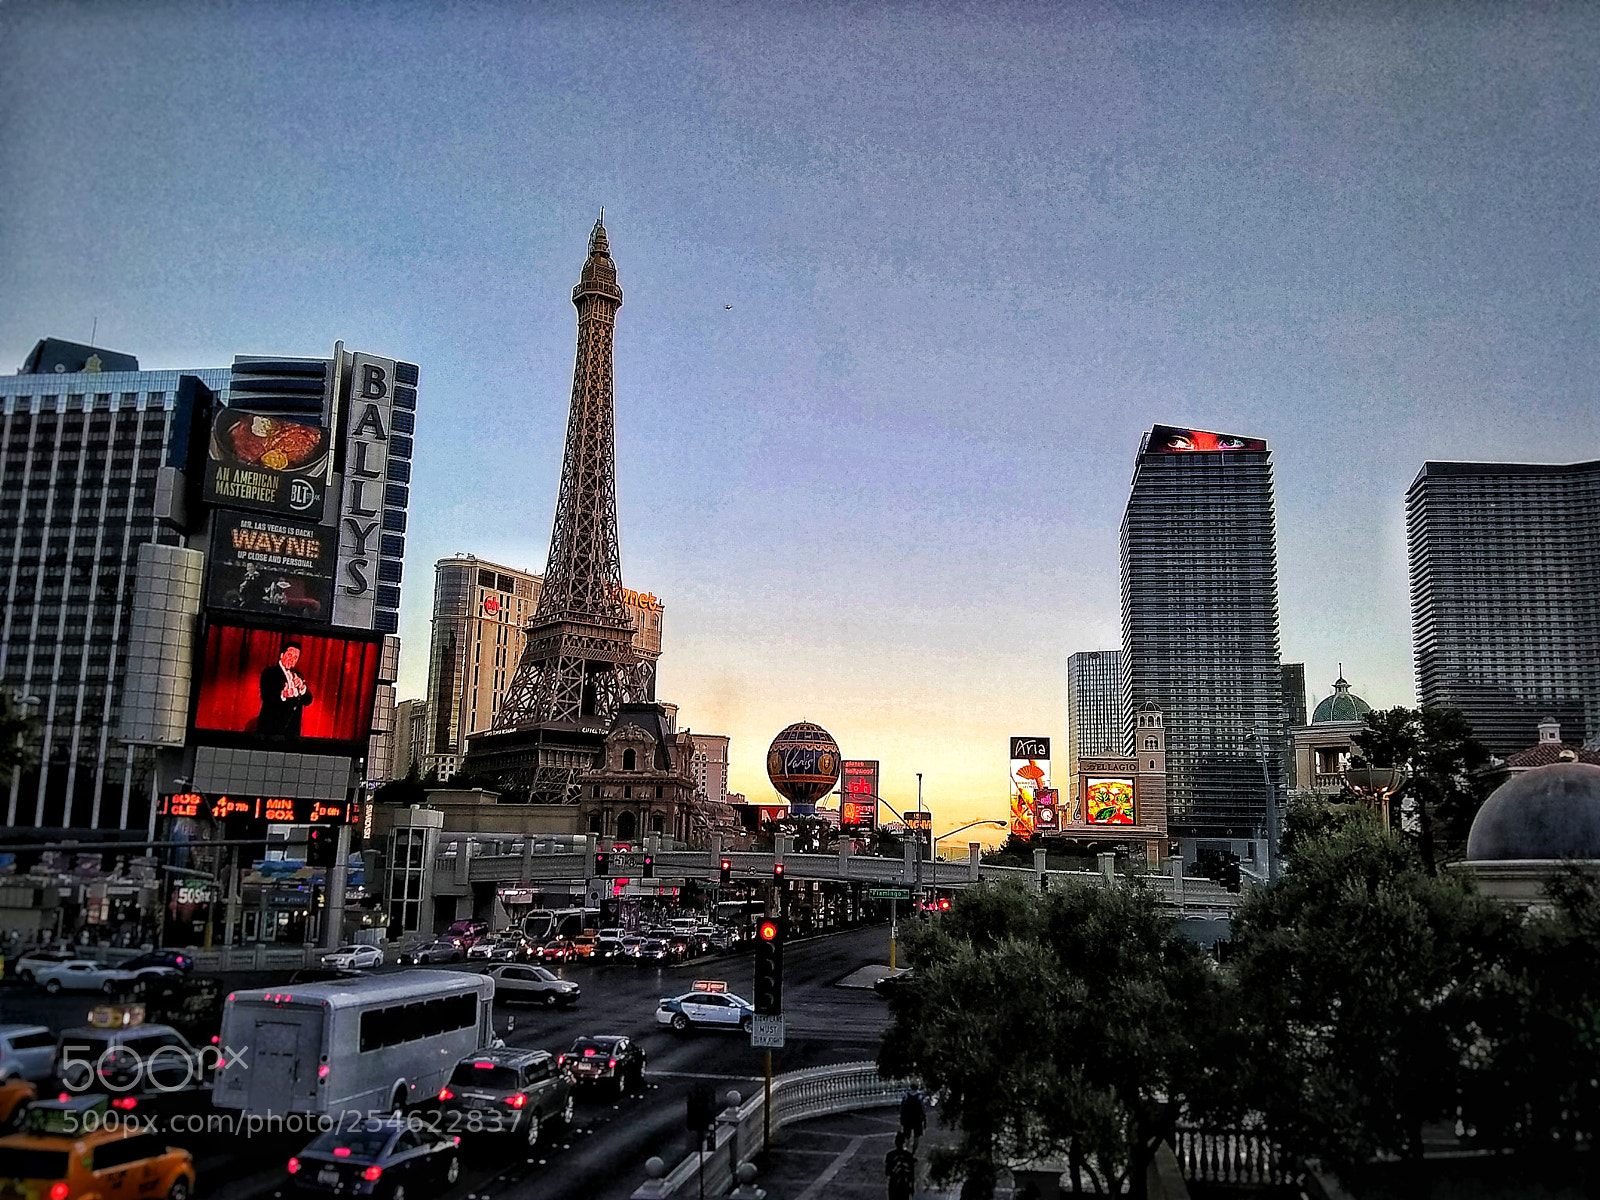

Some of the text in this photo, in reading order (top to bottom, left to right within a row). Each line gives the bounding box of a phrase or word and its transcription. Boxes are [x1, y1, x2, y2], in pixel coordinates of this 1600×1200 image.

[216, 466, 279, 489] AN AMERICAN
[215, 481, 276, 503] MASTERPIECE
[290, 484, 309, 503] BLT
[240, 520, 314, 538] MR. LAS VEGAS IS BACK!
[231, 528, 320, 558] WAYNE
[237, 550, 314, 568] UP CLOSE AND PERSONAL
[1015, 739, 1046, 756] Aria
[784, 746, 813, 779] Paris
[1083, 762, 1137, 771] BELLAGIO
[217, 796, 228, 807] 4
[266, 799, 320, 811] MIN 1
[170, 805, 227, 818] CLE 11
[265, 810, 294, 820] SOX
[872, 890, 902, 898] Flamingo
[760, 1024, 778, 1034] MUST
